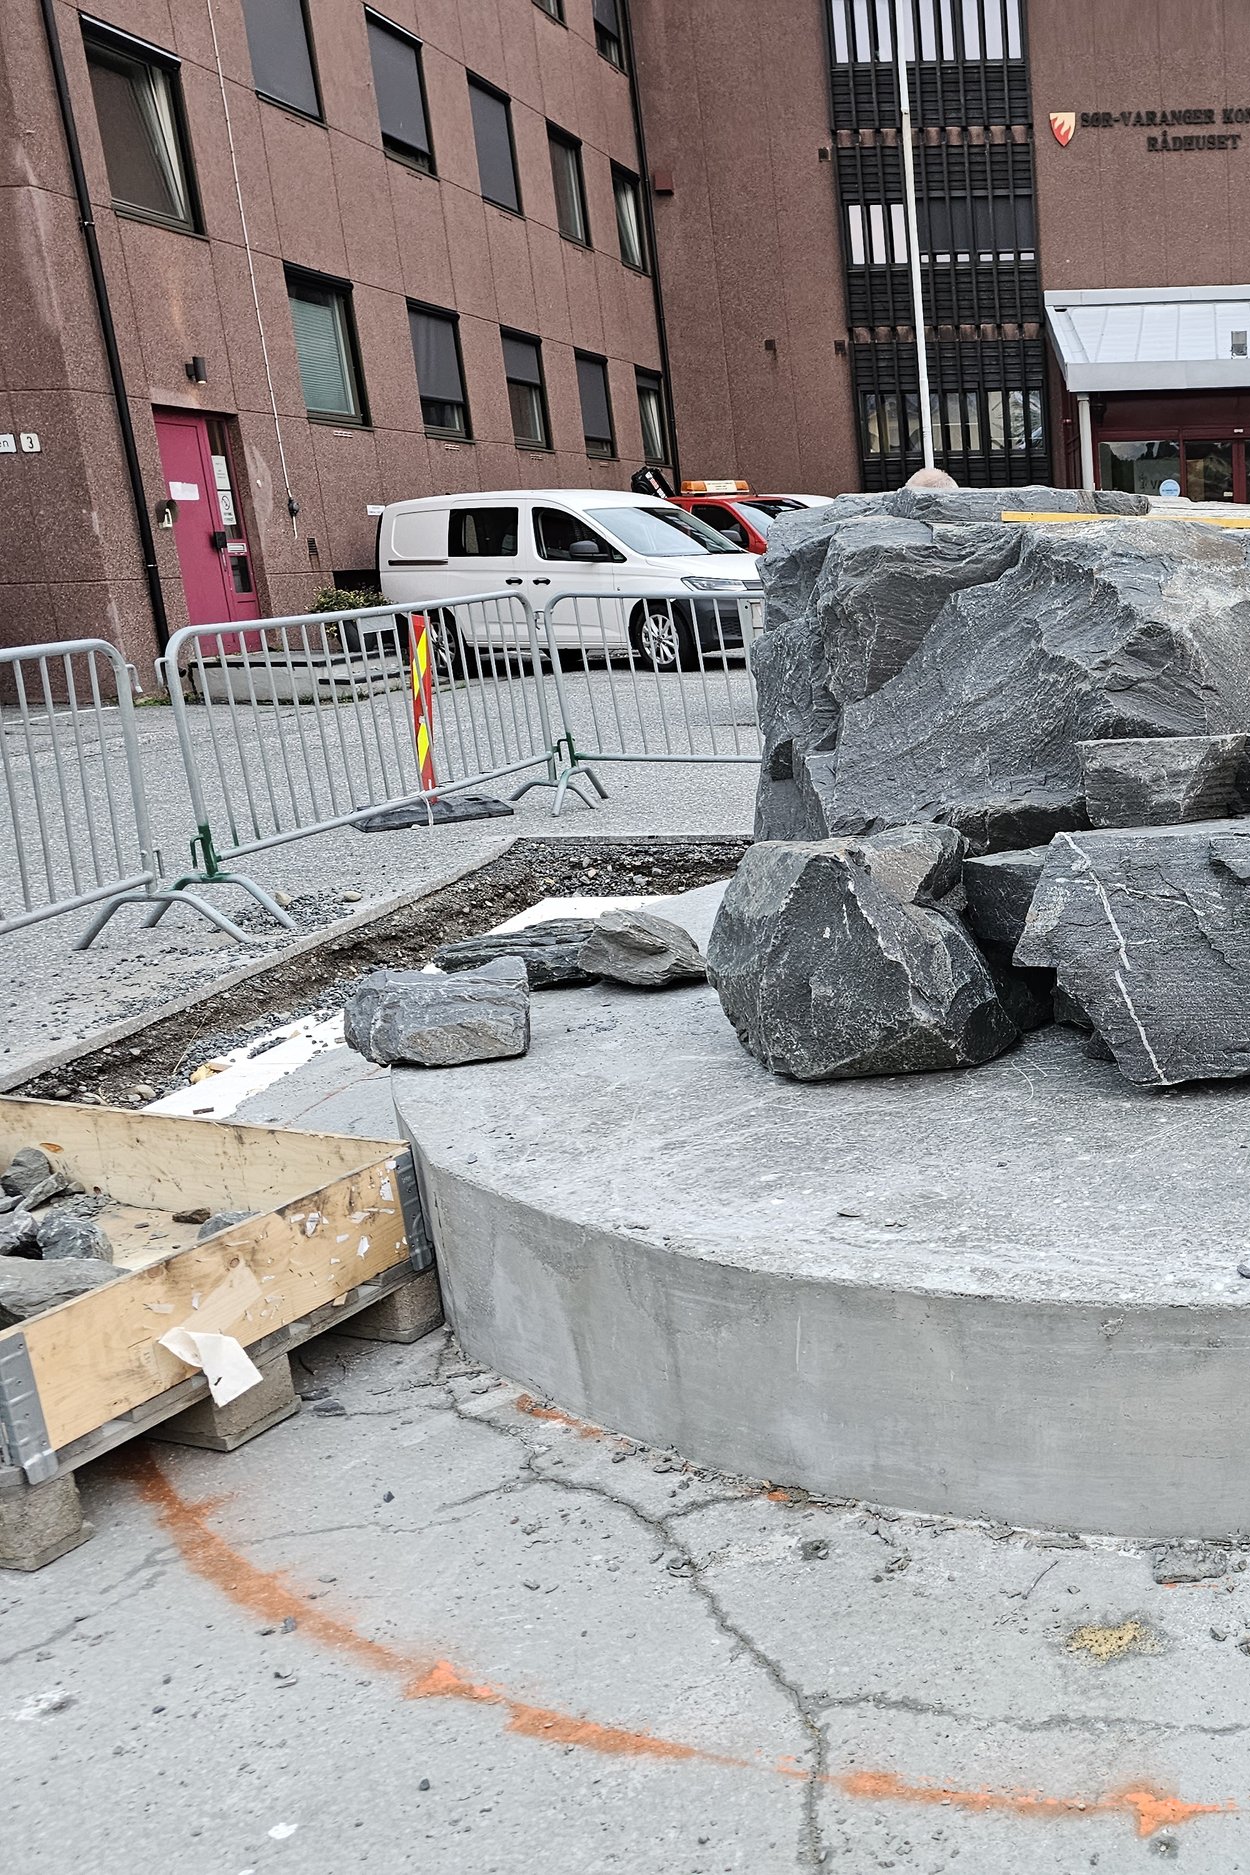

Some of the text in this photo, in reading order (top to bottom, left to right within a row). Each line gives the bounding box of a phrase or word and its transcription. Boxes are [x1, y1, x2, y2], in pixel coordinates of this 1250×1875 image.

[1080, 109, 1216, 128] SØR-VARANGER
[1146, 130, 1242, 152] RÅDHUSET
[26, 436, 34, 449] 3
